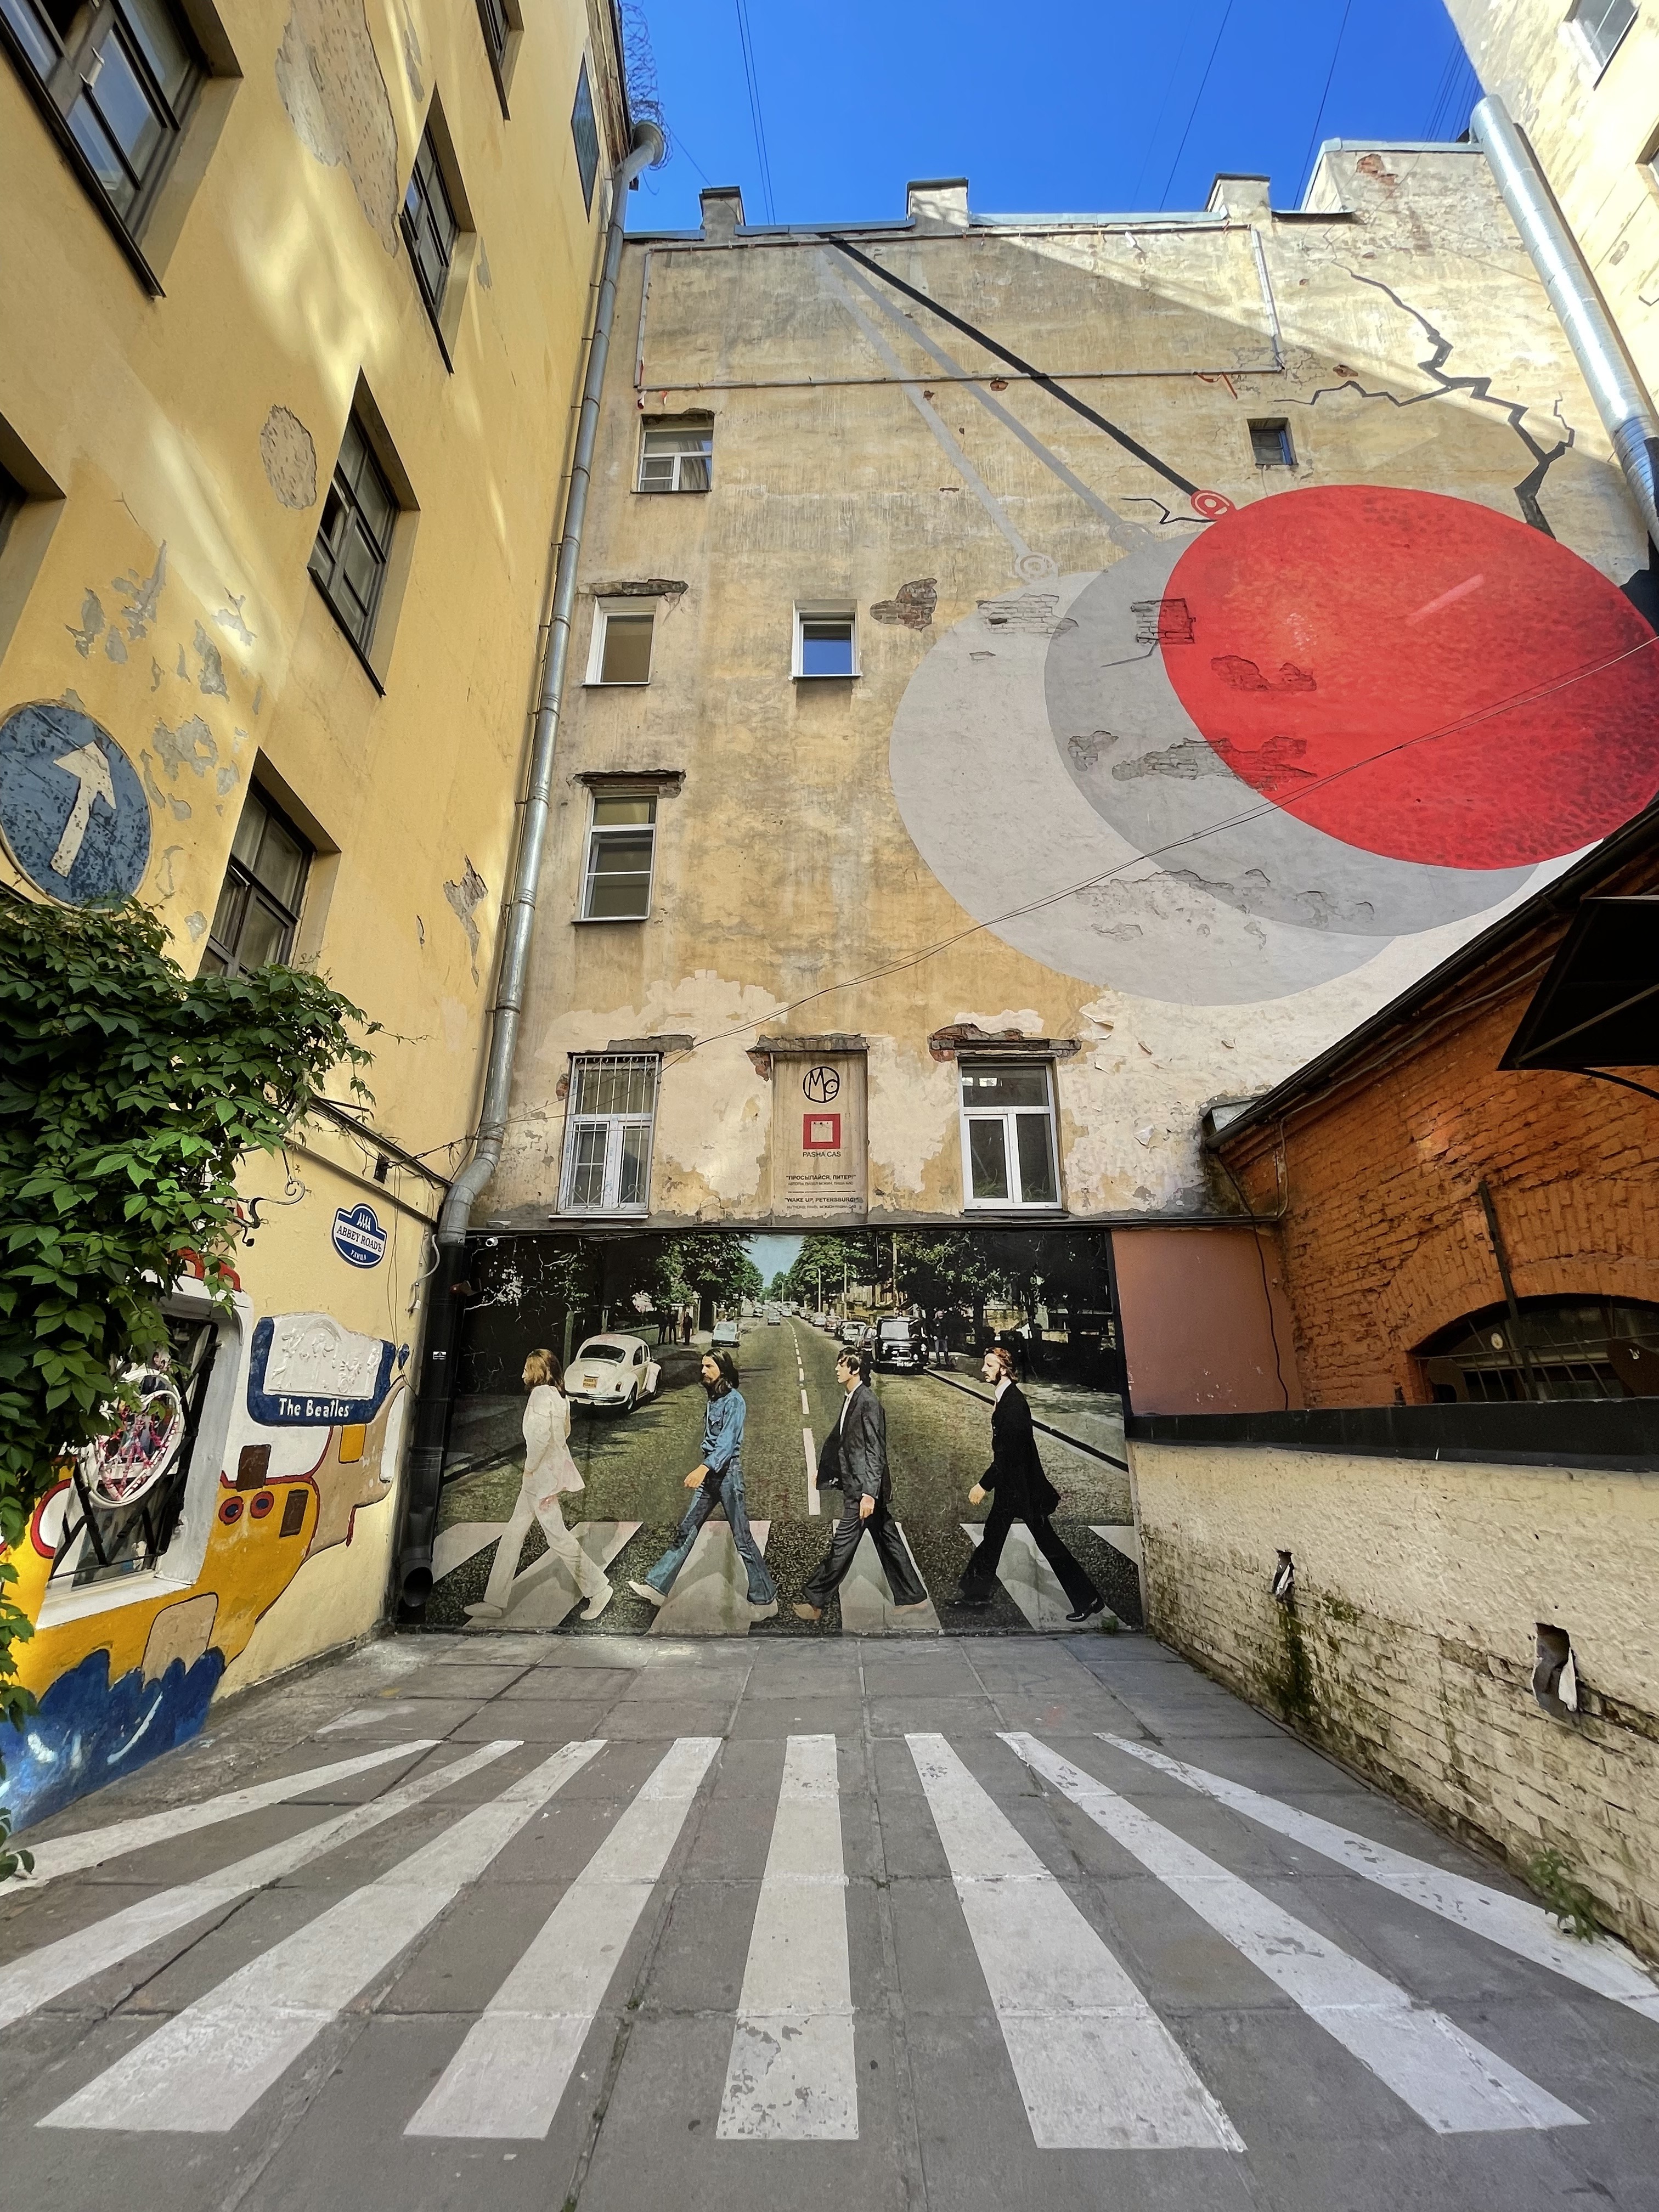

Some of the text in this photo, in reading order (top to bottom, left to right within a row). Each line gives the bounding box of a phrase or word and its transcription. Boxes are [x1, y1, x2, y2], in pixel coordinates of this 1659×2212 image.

[336, 1225, 360, 1242] ABBEY
[351, 1249, 366, 1261] УЛИЦА
[279, 1398, 349, 1418] The Beatles
